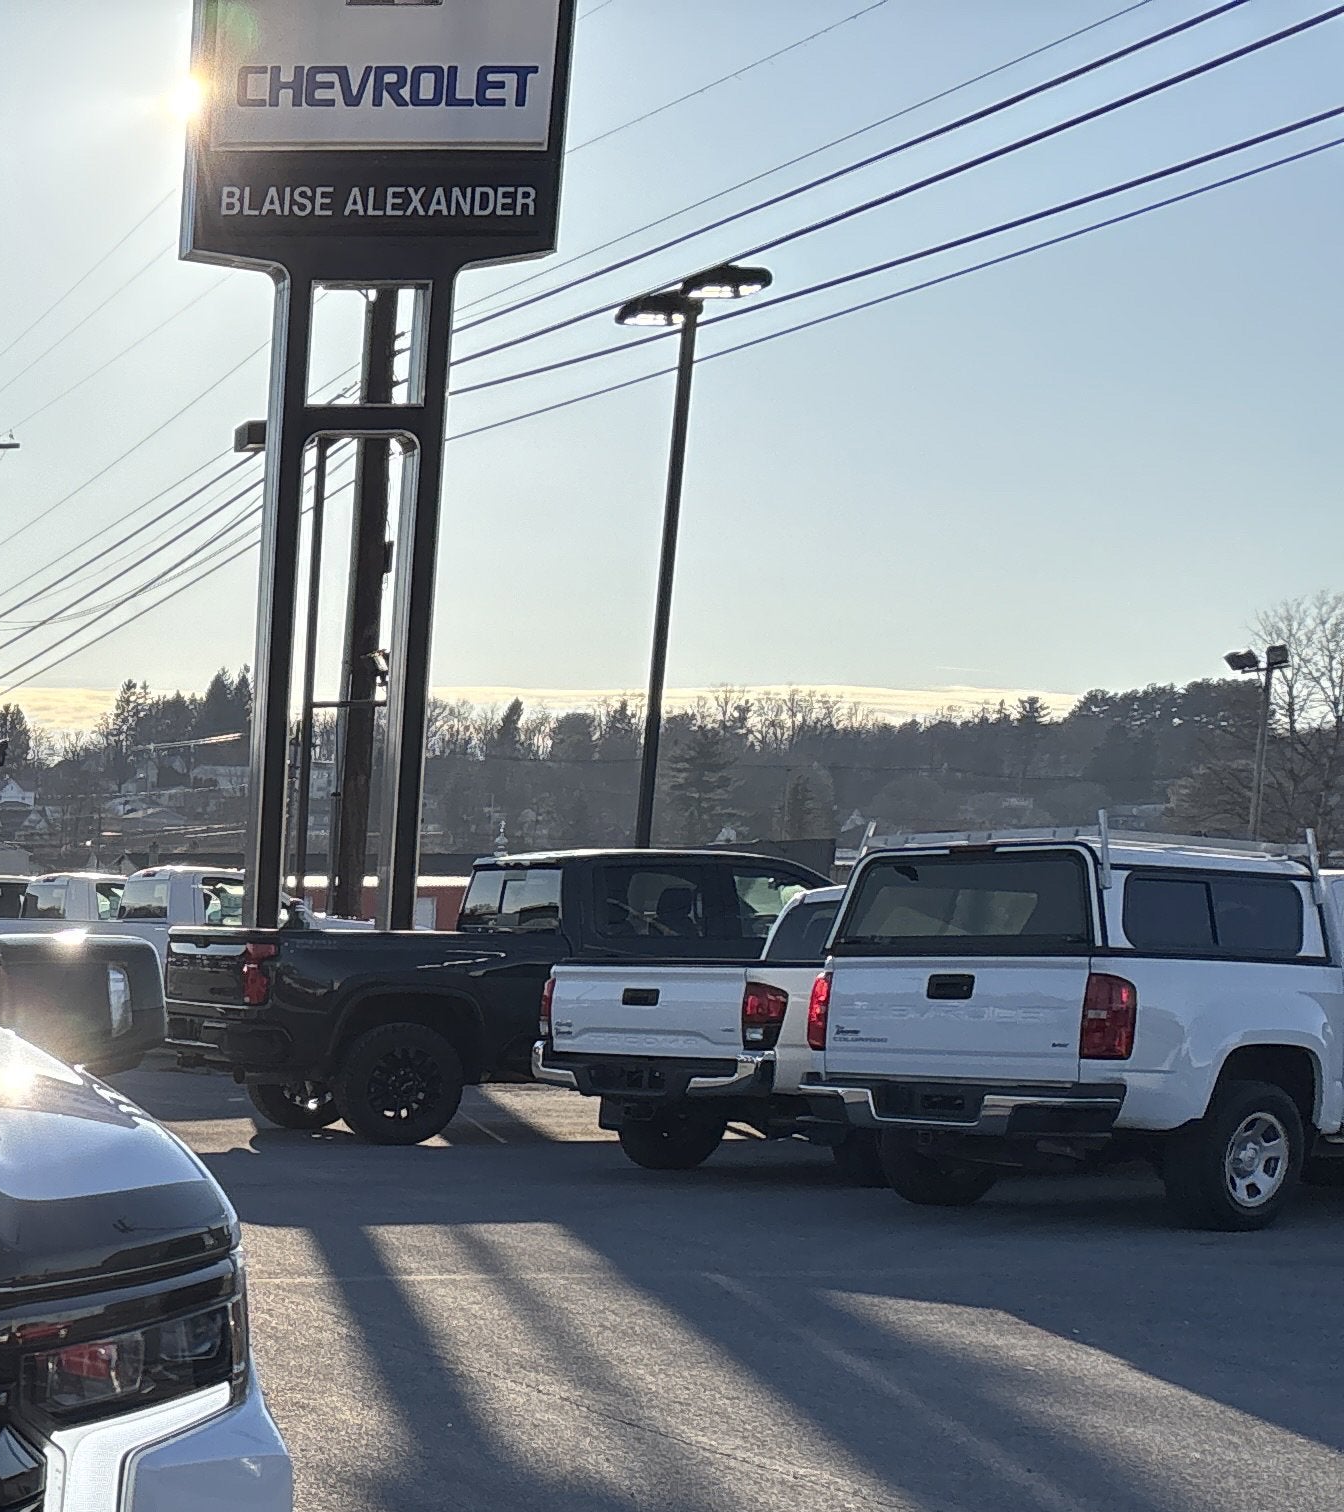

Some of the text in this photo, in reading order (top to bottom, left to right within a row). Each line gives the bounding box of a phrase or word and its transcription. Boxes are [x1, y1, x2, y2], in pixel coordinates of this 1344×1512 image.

[237, 65, 539, 107] CHEVROLET
[221, 186, 536, 216] BLAISE ALEXANDER
